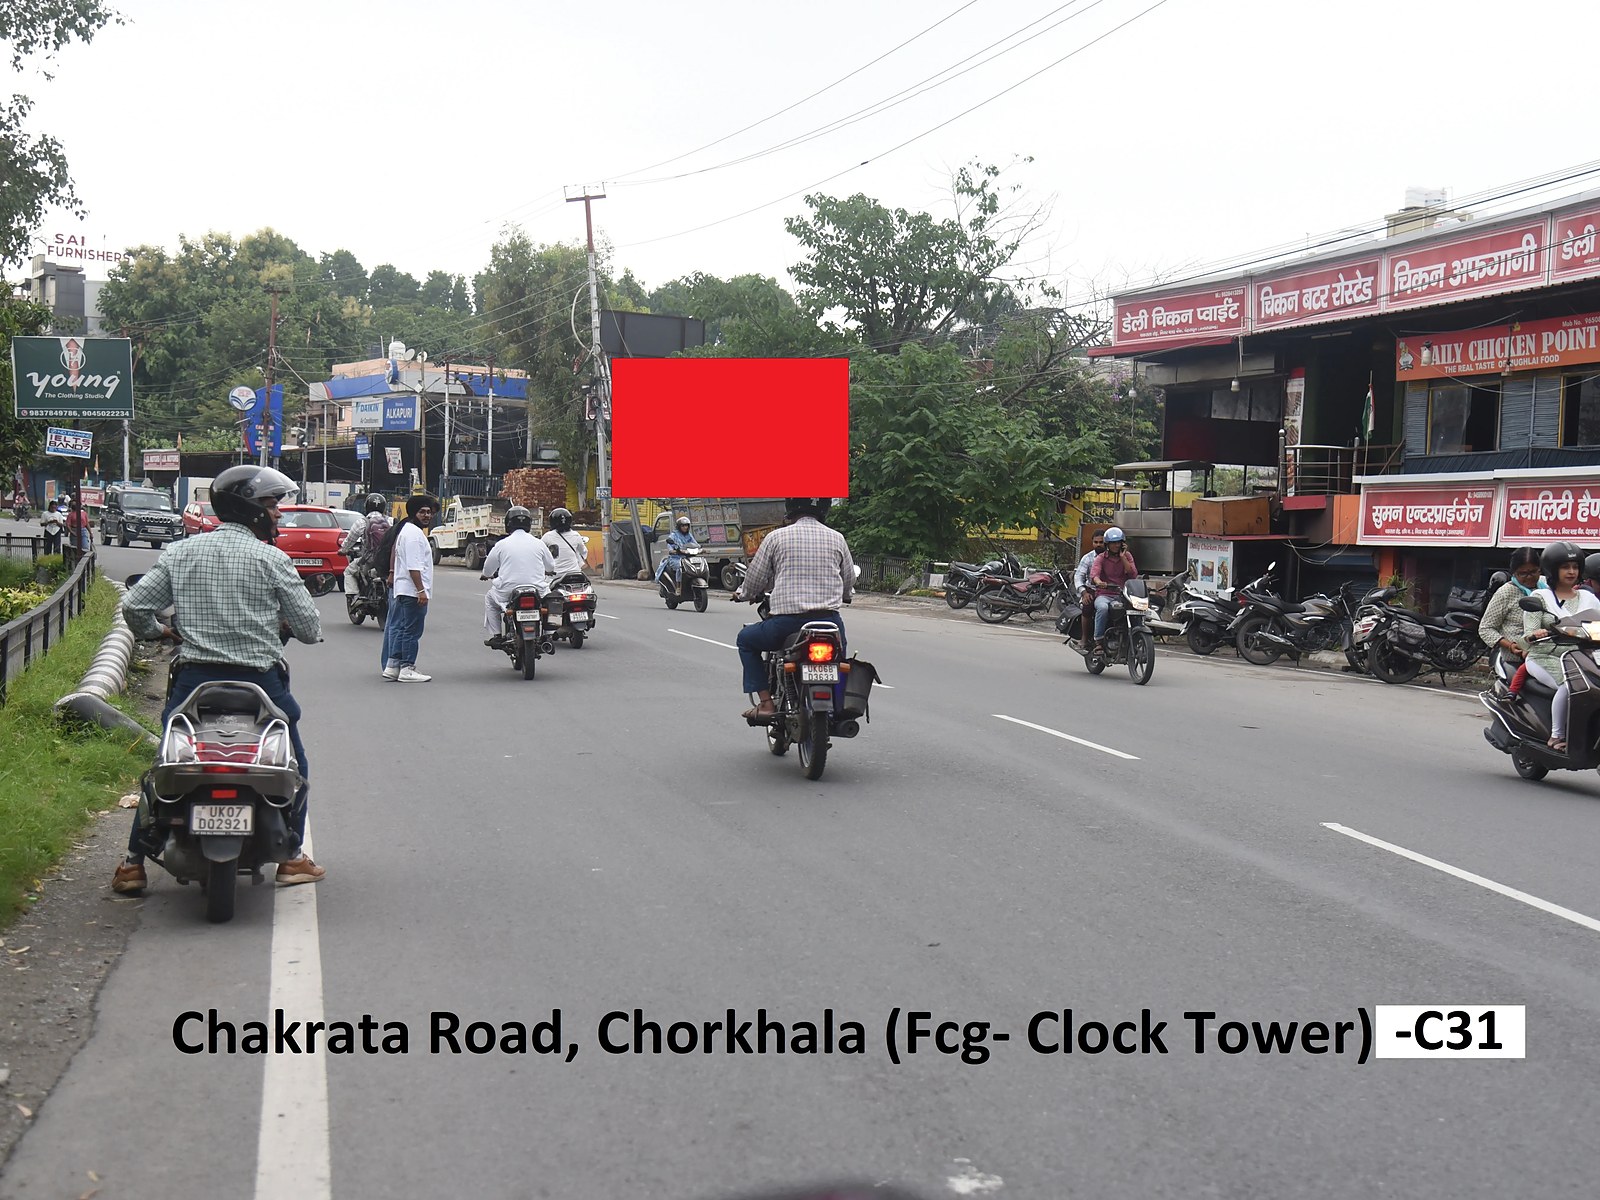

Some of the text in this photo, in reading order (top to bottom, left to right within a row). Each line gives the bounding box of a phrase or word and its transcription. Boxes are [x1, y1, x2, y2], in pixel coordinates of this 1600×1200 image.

[55, 233, 85, 246] SAI
[47, 245, 129, 262] FURNISHERS
[1393, 233, 1538, 297] चिकन अफगानी
[1260, 269, 1374, 318] चिकन बटर रोस्टेड
[1121, 308, 1149, 334] डेली
[1152, 306, 1194, 329] चिकन
[1468, 333, 1536, 361] CHICKEN
[1541, 325, 1599, 355] POINT
[1444, 365, 1457, 374] THE
[1457, 363, 1474, 373] REAL
[1475, 361, 1495, 371] TASTE
[1540, 354, 1560, 364] FOOD
[26, 372, 121, 399] young
[57, 392, 83, 400] Clothing
[360, 403, 379, 413] DAIKIN
[386, 407, 413, 419] ALKAPURI
[49, 434, 91, 446] IELTS
[1509, 489, 1574, 521] क्वालिटी
[1372, 505, 1404, 529] सुमन
[209, 806, 243, 818] UK07
